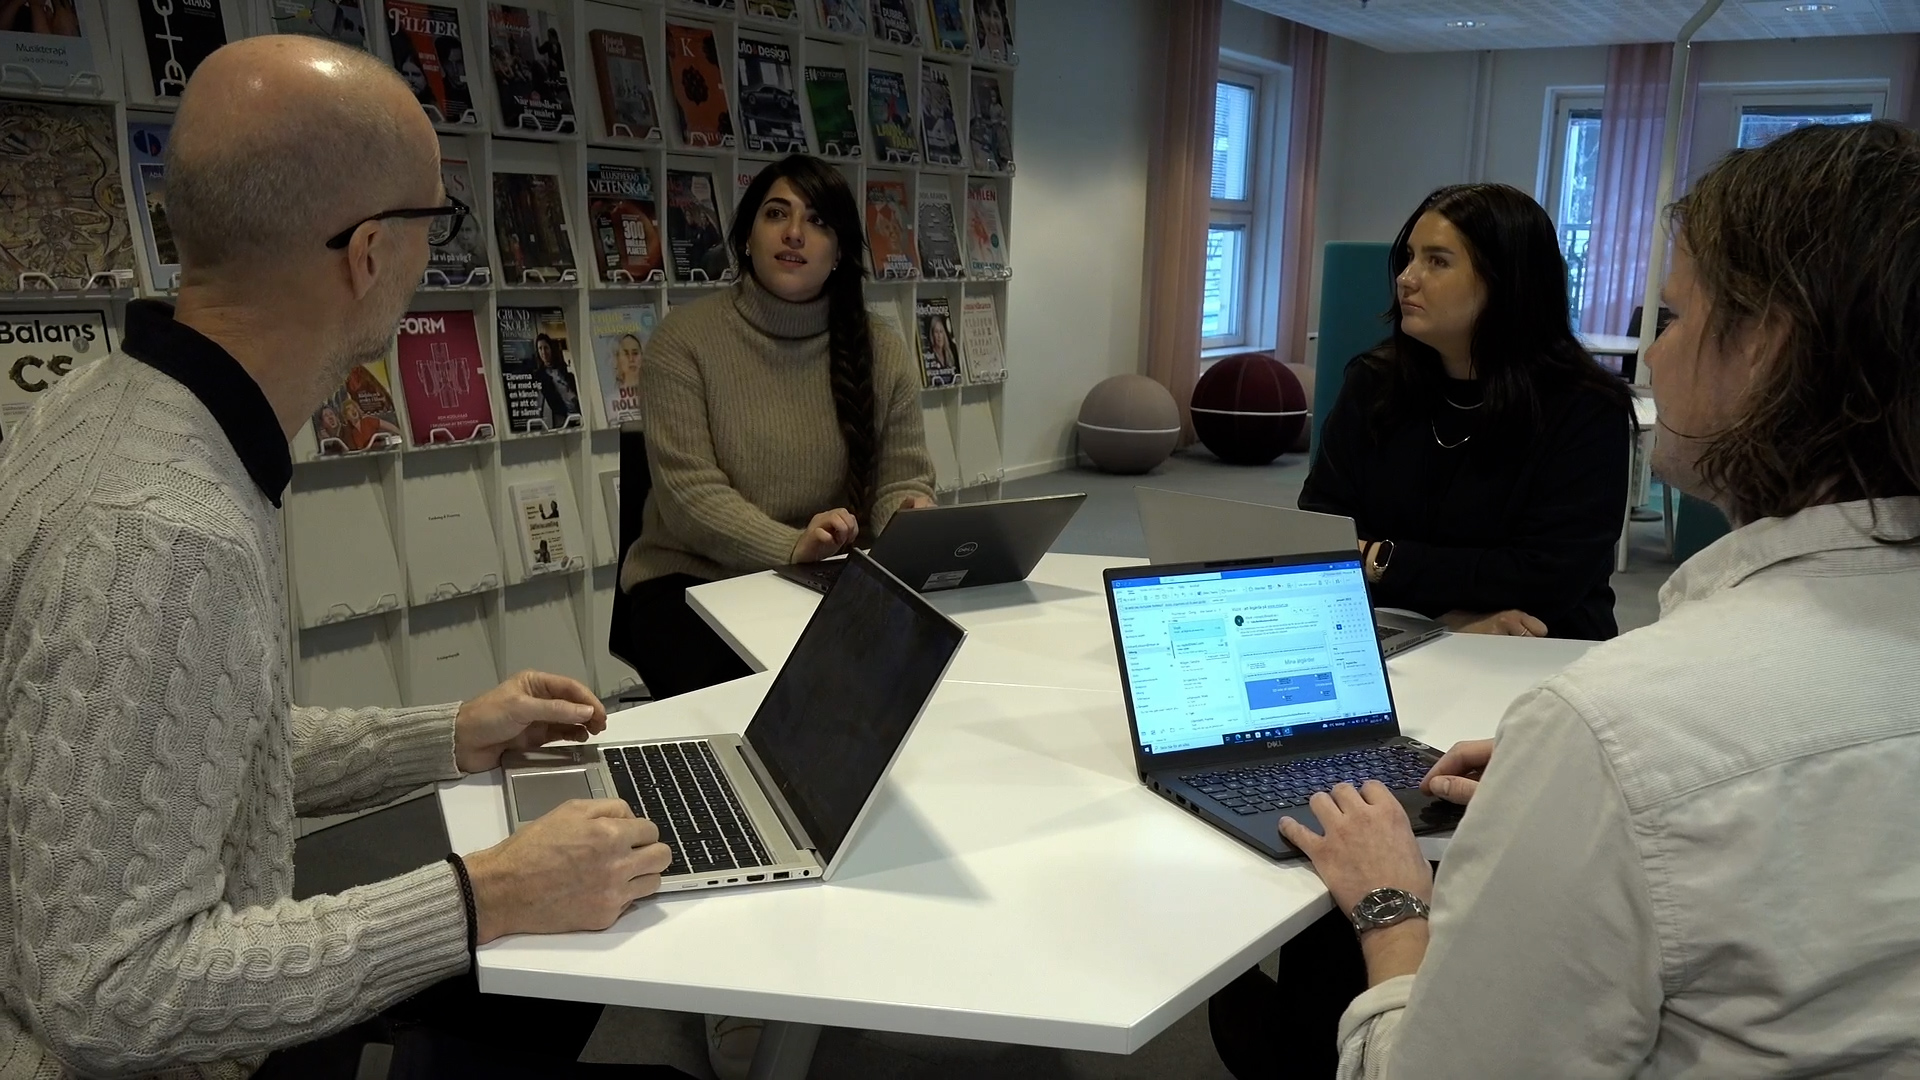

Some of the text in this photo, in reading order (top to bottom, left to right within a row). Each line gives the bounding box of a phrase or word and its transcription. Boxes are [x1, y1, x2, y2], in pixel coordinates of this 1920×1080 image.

[388, 8, 460, 38] FILTER
[16, 43, 67, 56] Musikterapi
[681, 37, 696, 57] K
[758, 46, 790, 61] Design
[588, 178, 651, 197] VETENSKAP
[622, 220, 646, 240] 300
[498, 309, 531, 322] GRUND
[0, 319, 96, 344] Balans
[397, 316, 447, 335] FORM
[518, 380, 532, 390] med
[533, 380, 543, 391] sig
[520, 399, 529, 408] att
[530, 399, 538, 408] de
[1266, 740, 1284, 749] DELL
